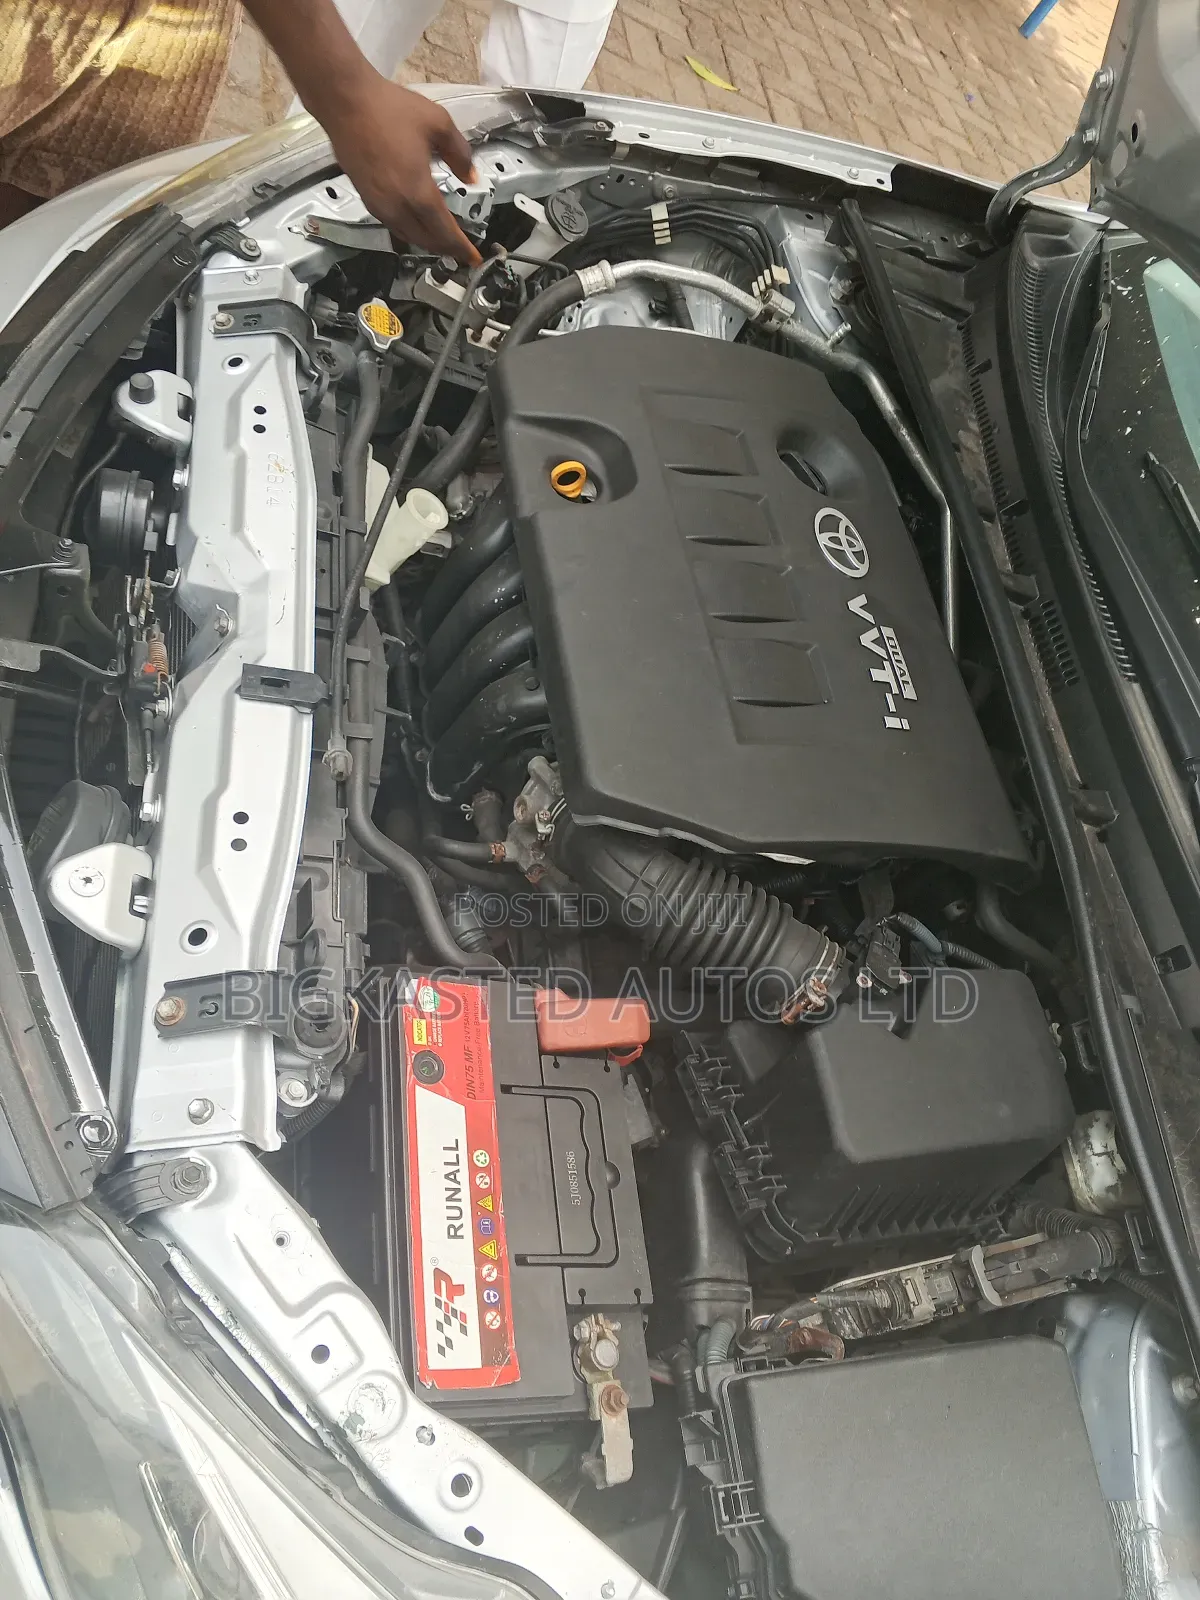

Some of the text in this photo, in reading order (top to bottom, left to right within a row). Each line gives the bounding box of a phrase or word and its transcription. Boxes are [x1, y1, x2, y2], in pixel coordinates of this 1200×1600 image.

[847, 593, 910, 730] VVT-i
[886, 636, 910, 692] DUAL
[463, 1045, 473, 1063] MF
[464, 1064, 477, 1100] DIN75
[443, 1138, 464, 1240] RUNALL
[565, 1151, 581, 1206] 5J0851586
